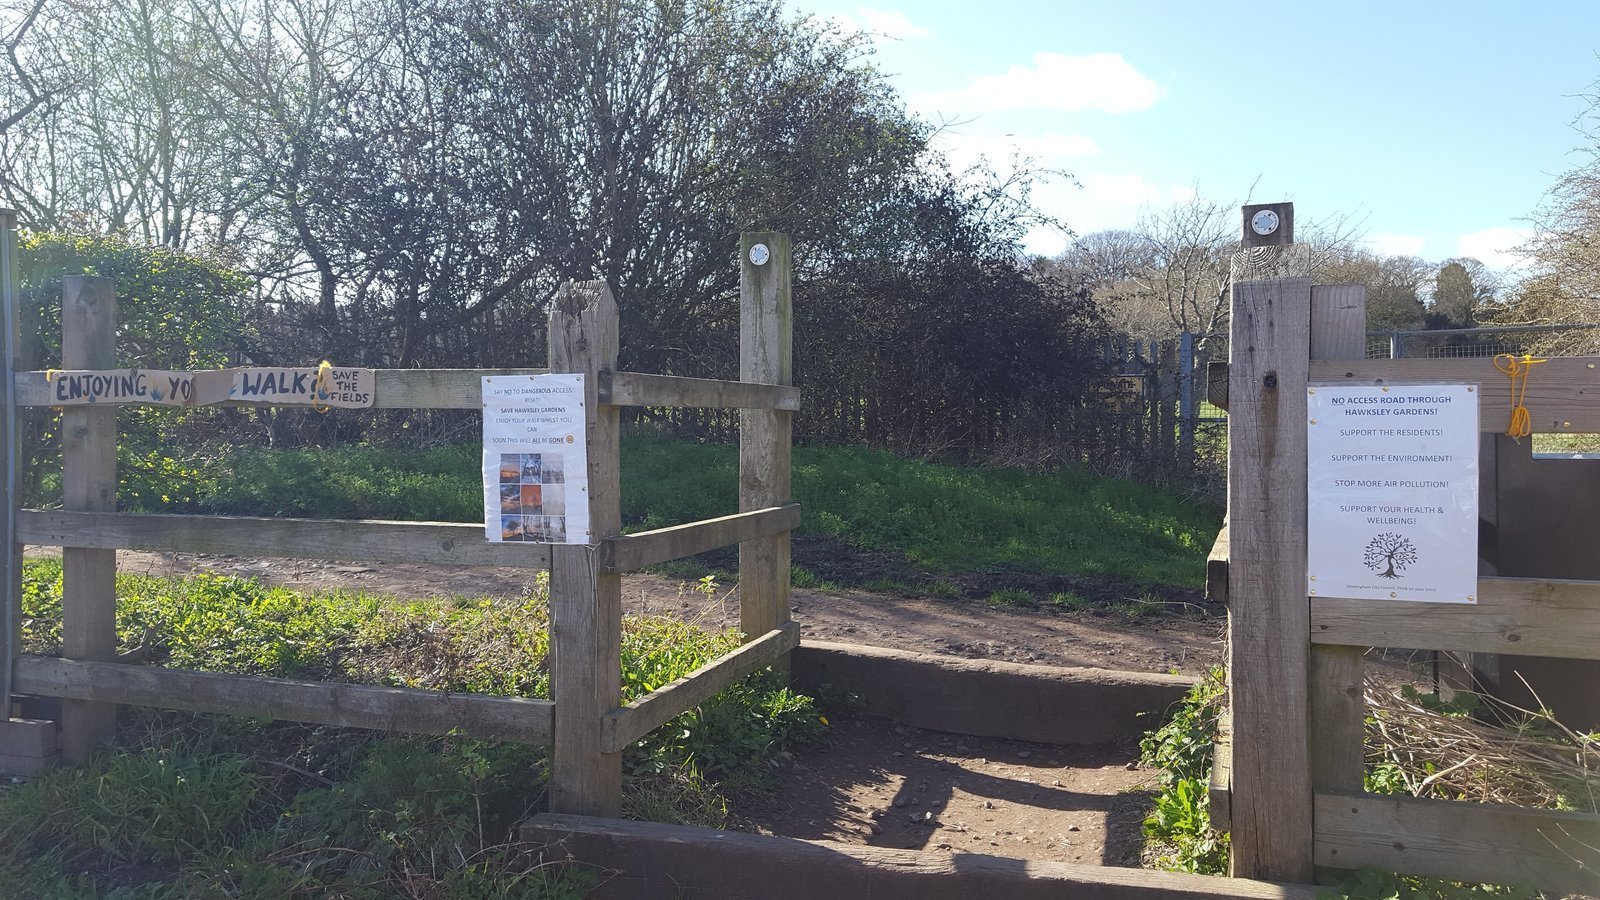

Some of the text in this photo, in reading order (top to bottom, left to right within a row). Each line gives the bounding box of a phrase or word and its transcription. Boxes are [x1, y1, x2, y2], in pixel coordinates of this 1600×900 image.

[332, 370, 359, 381] SAVE
[56, 372, 147, 400] ENJOYING
[168, 376, 191, 400] YO
[336, 381, 358, 392] THE
[330, 392, 369, 403] FIELDS
[1331, 396, 1452, 406] NO ACCESS ROAD THROUGH
[1345, 408, 1438, 416] HAWKSLEY GARDENS!
[1331, 454, 1368, 462] SUPPORT
[1371, 454, 1386, 462] THE
[1357, 480, 1382, 488] MORE
[1384, 480, 1398, 488] AIR
[1399, 480, 1449, 488] POLLUTION!
[1340, 505, 1377, 513] SUPPORT
[1379, 505, 1402, 513] YOUR
[1403, 506, 1435, 514] HEALTH
[1367, 517, 1416, 525] WELLBEING!
